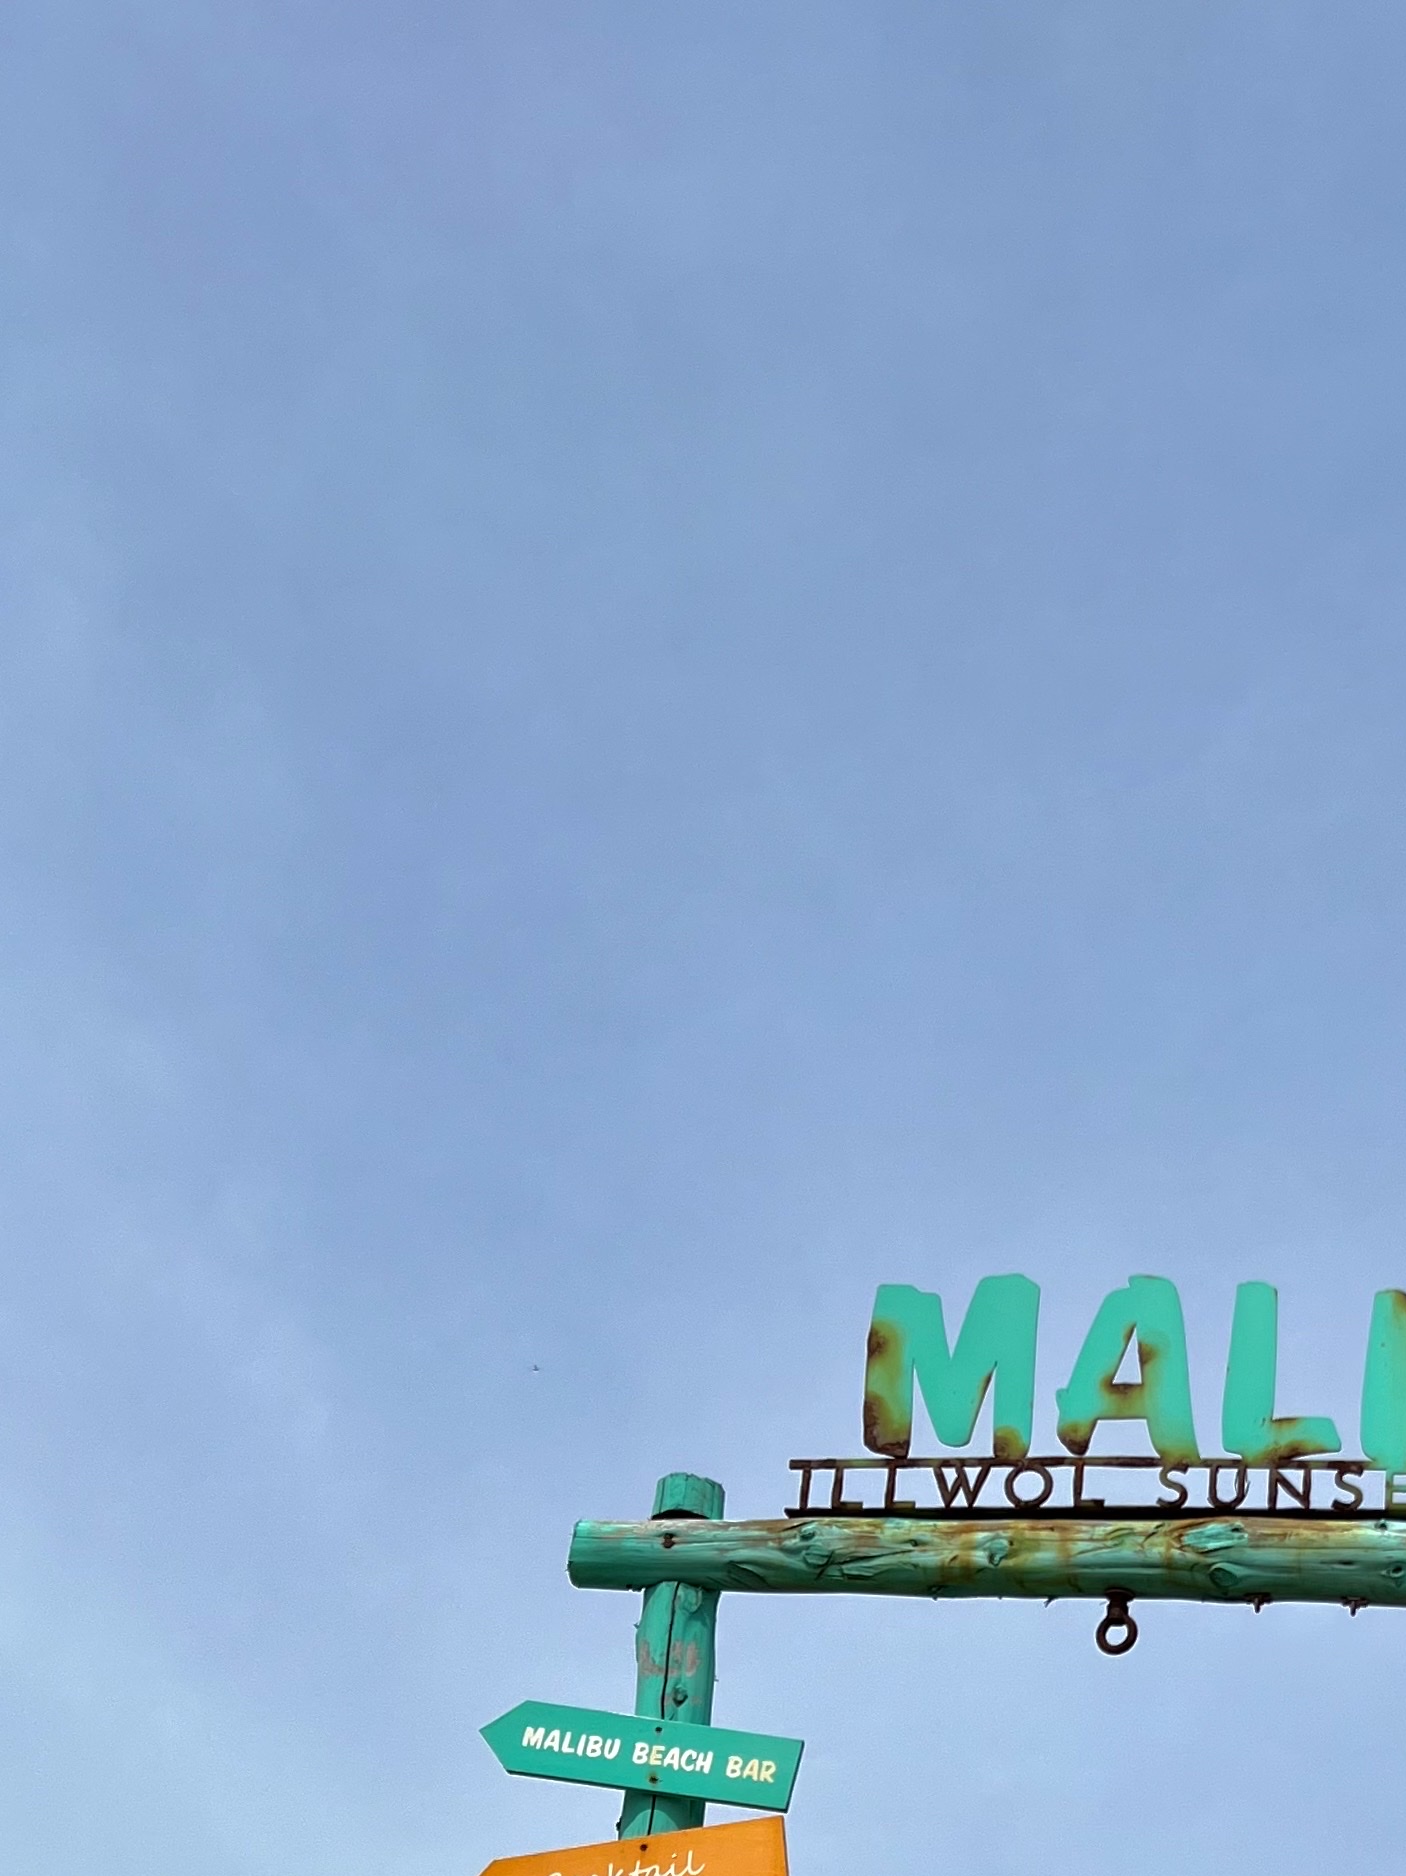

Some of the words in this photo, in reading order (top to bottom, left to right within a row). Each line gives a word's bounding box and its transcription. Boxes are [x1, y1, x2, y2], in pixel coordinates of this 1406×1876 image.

[795, 1461, 1104, 1512] ILLWOL
[521, 1726, 621, 1760] MALIBU
[631, 1742, 713, 1774] BEACH
[725, 1756, 776, 1784] BAR
